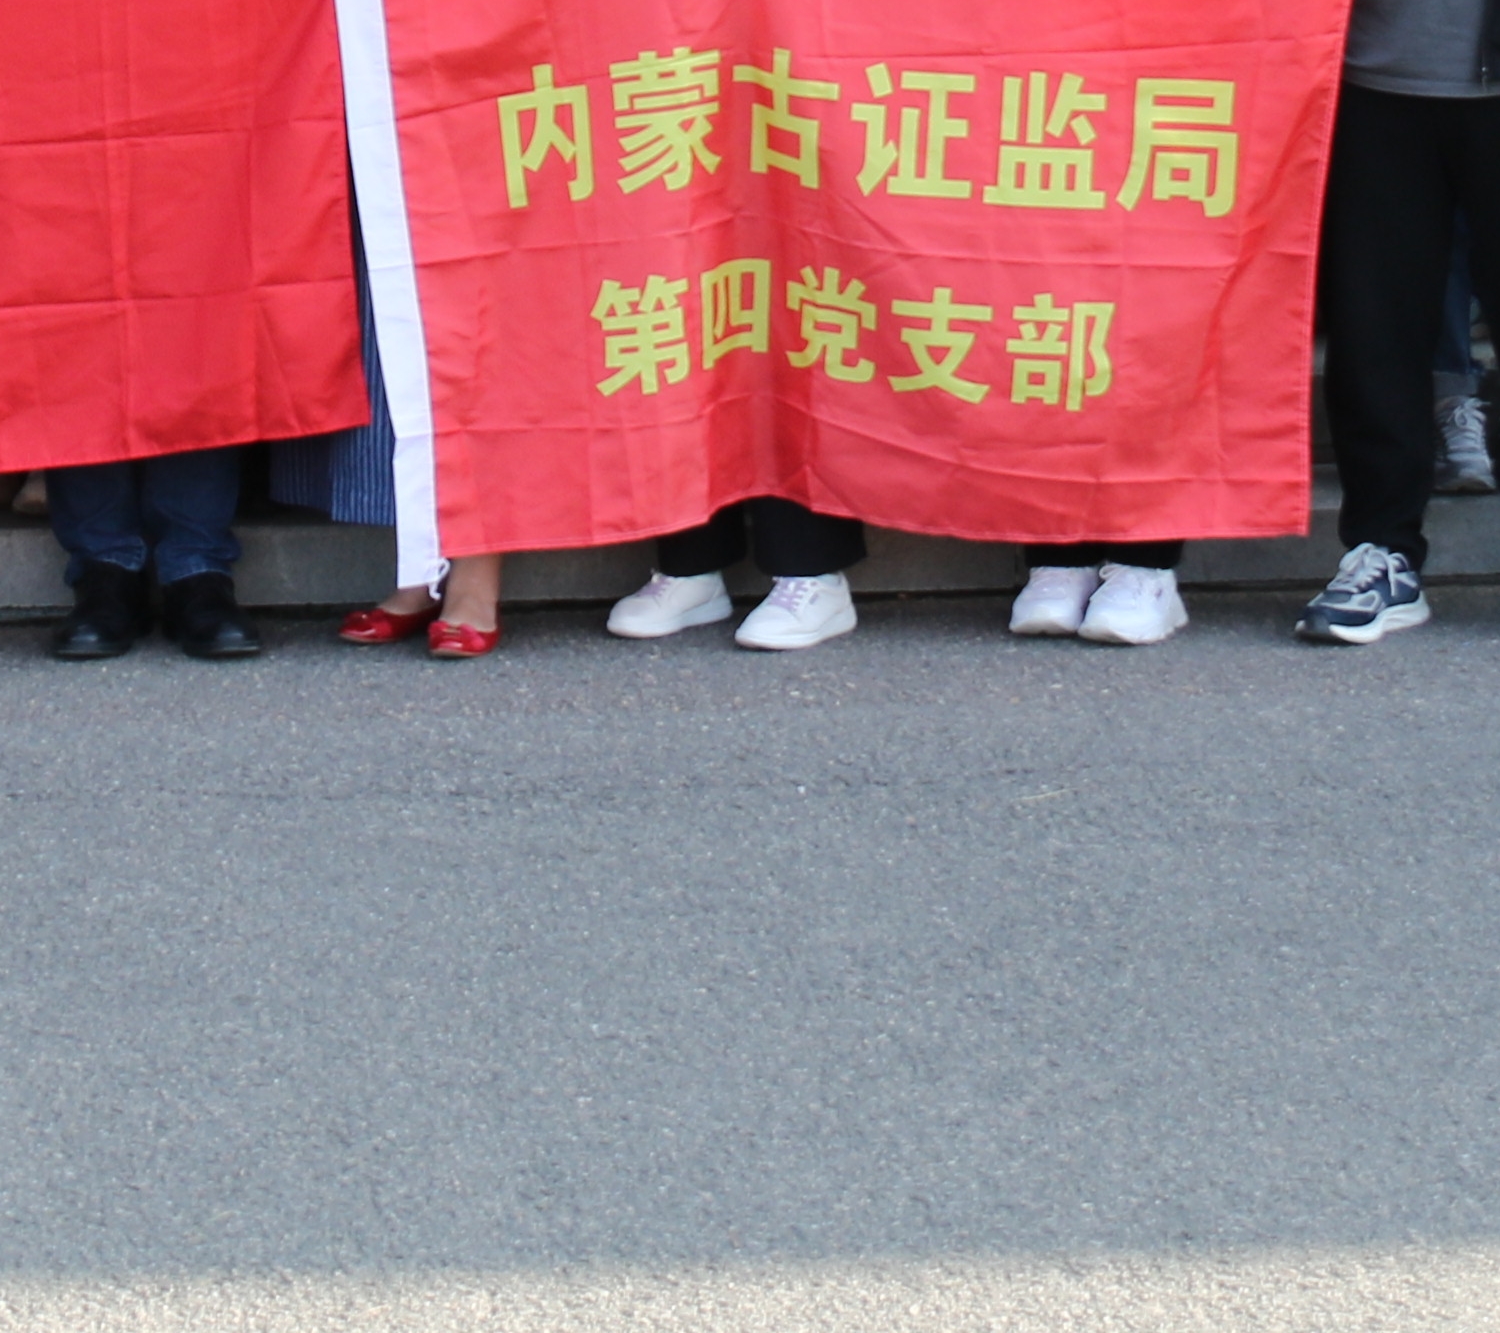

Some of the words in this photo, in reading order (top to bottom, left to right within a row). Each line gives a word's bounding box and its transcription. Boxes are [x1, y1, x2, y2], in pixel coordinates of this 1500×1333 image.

[497, 46, 1238, 218] 内蒙古证监局
[589, 258, 1116, 412] 第四党支部
